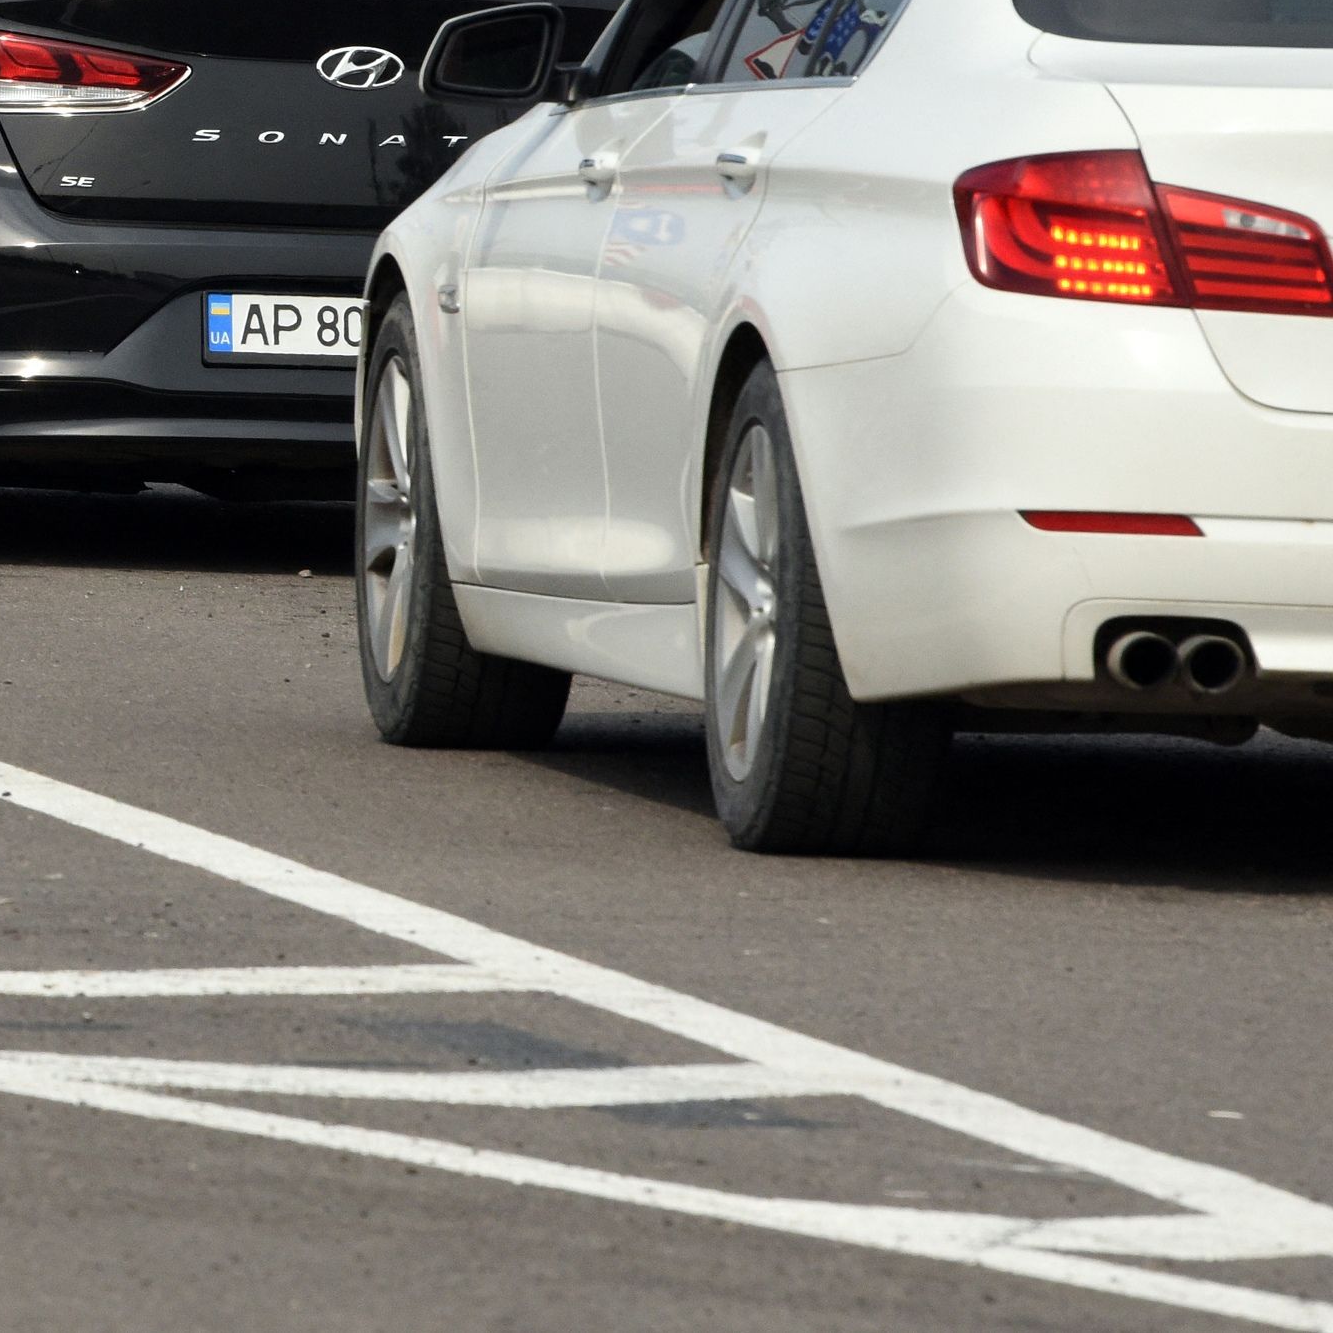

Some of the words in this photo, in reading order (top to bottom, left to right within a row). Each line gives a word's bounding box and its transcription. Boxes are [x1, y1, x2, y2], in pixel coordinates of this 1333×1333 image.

[60, 176, 95, 188] SE
[240, 303, 302, 347] AP
[210, 331, 230, 344] UA
